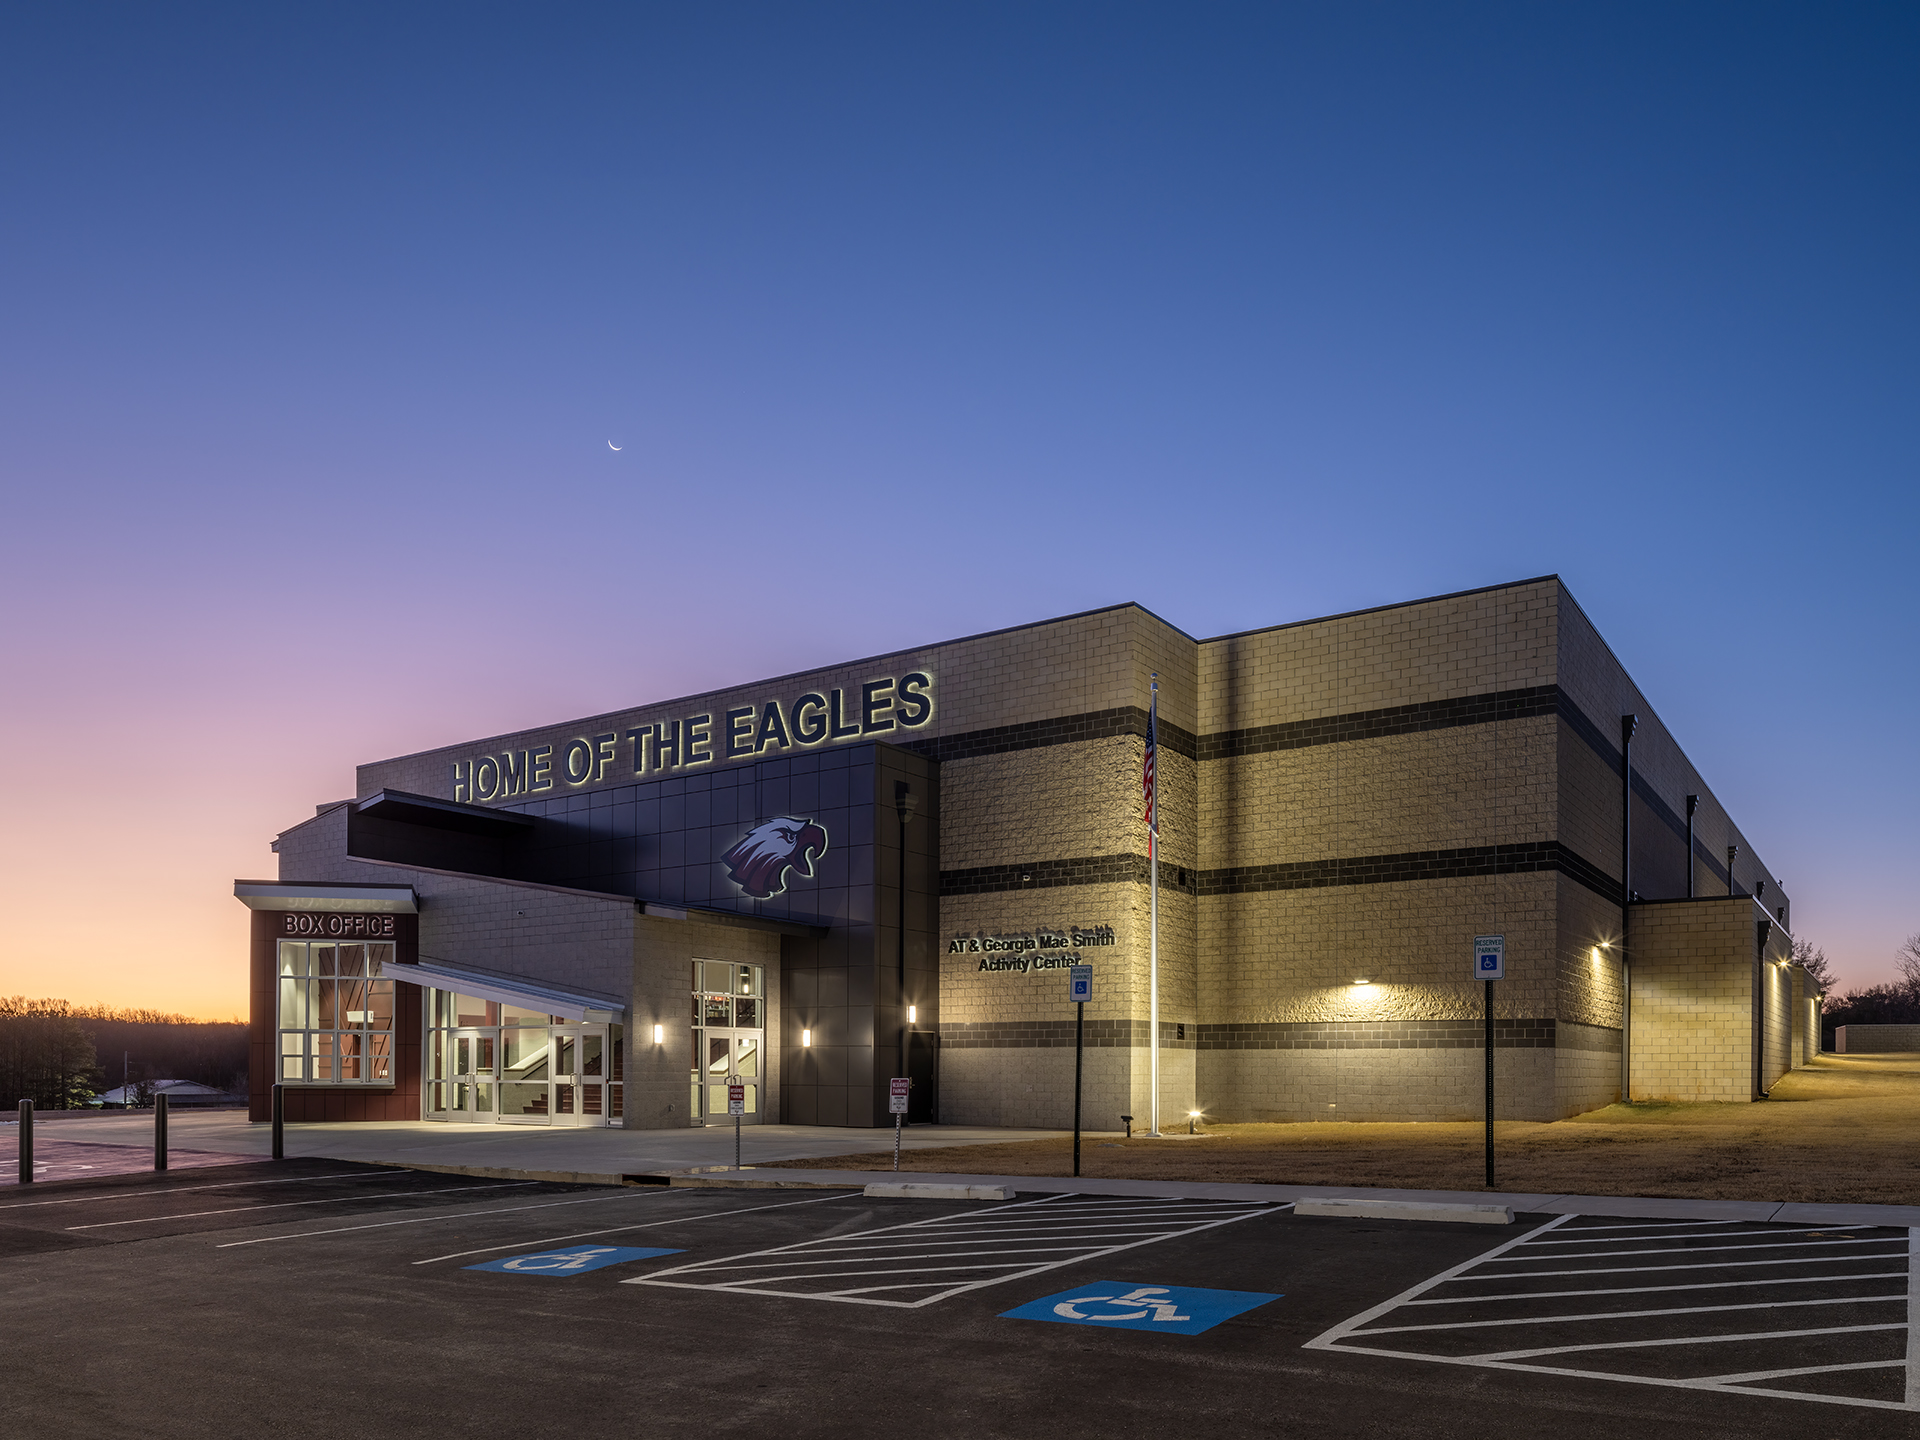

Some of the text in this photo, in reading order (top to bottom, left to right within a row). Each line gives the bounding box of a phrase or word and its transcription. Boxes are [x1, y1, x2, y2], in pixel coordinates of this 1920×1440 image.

[450, 672, 934, 803] HOME OF THE EAGLES
[284, 914, 394, 936] BOX OFFICE
[948, 932, 1116, 953] AT & Georgia Mae Smith
[978, 955, 1081, 973] Activity Center
